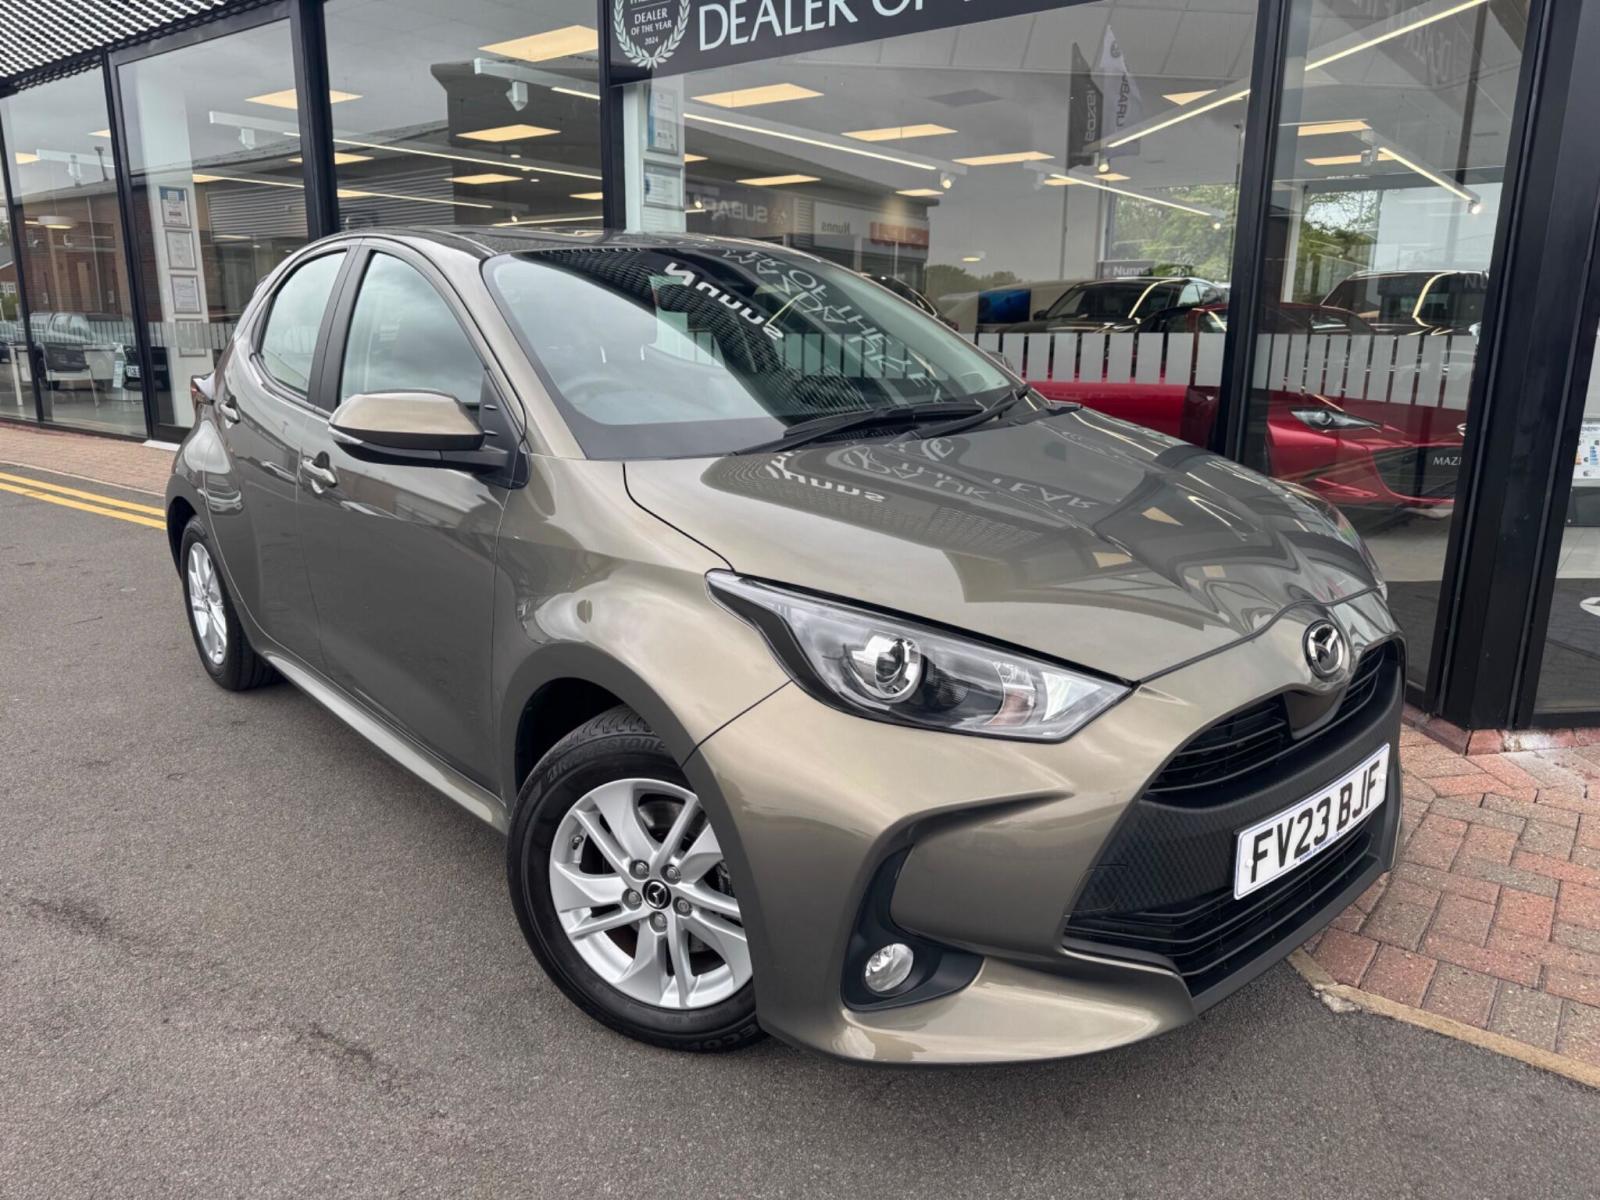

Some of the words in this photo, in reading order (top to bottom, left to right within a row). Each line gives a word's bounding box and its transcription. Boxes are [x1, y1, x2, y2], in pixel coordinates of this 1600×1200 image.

[634, 8, 668, 25] DEALER
[630, 27, 641, 36] OF
[641, 24, 654, 33] THE
[655, 20, 672, 31] YEAR
[700, 0, 859, 51] DEALER
[1432, 456, 1462, 466] MAZ
[1251, 796, 1331, 883] FV23
[1337, 760, 1380, 832] BJF
